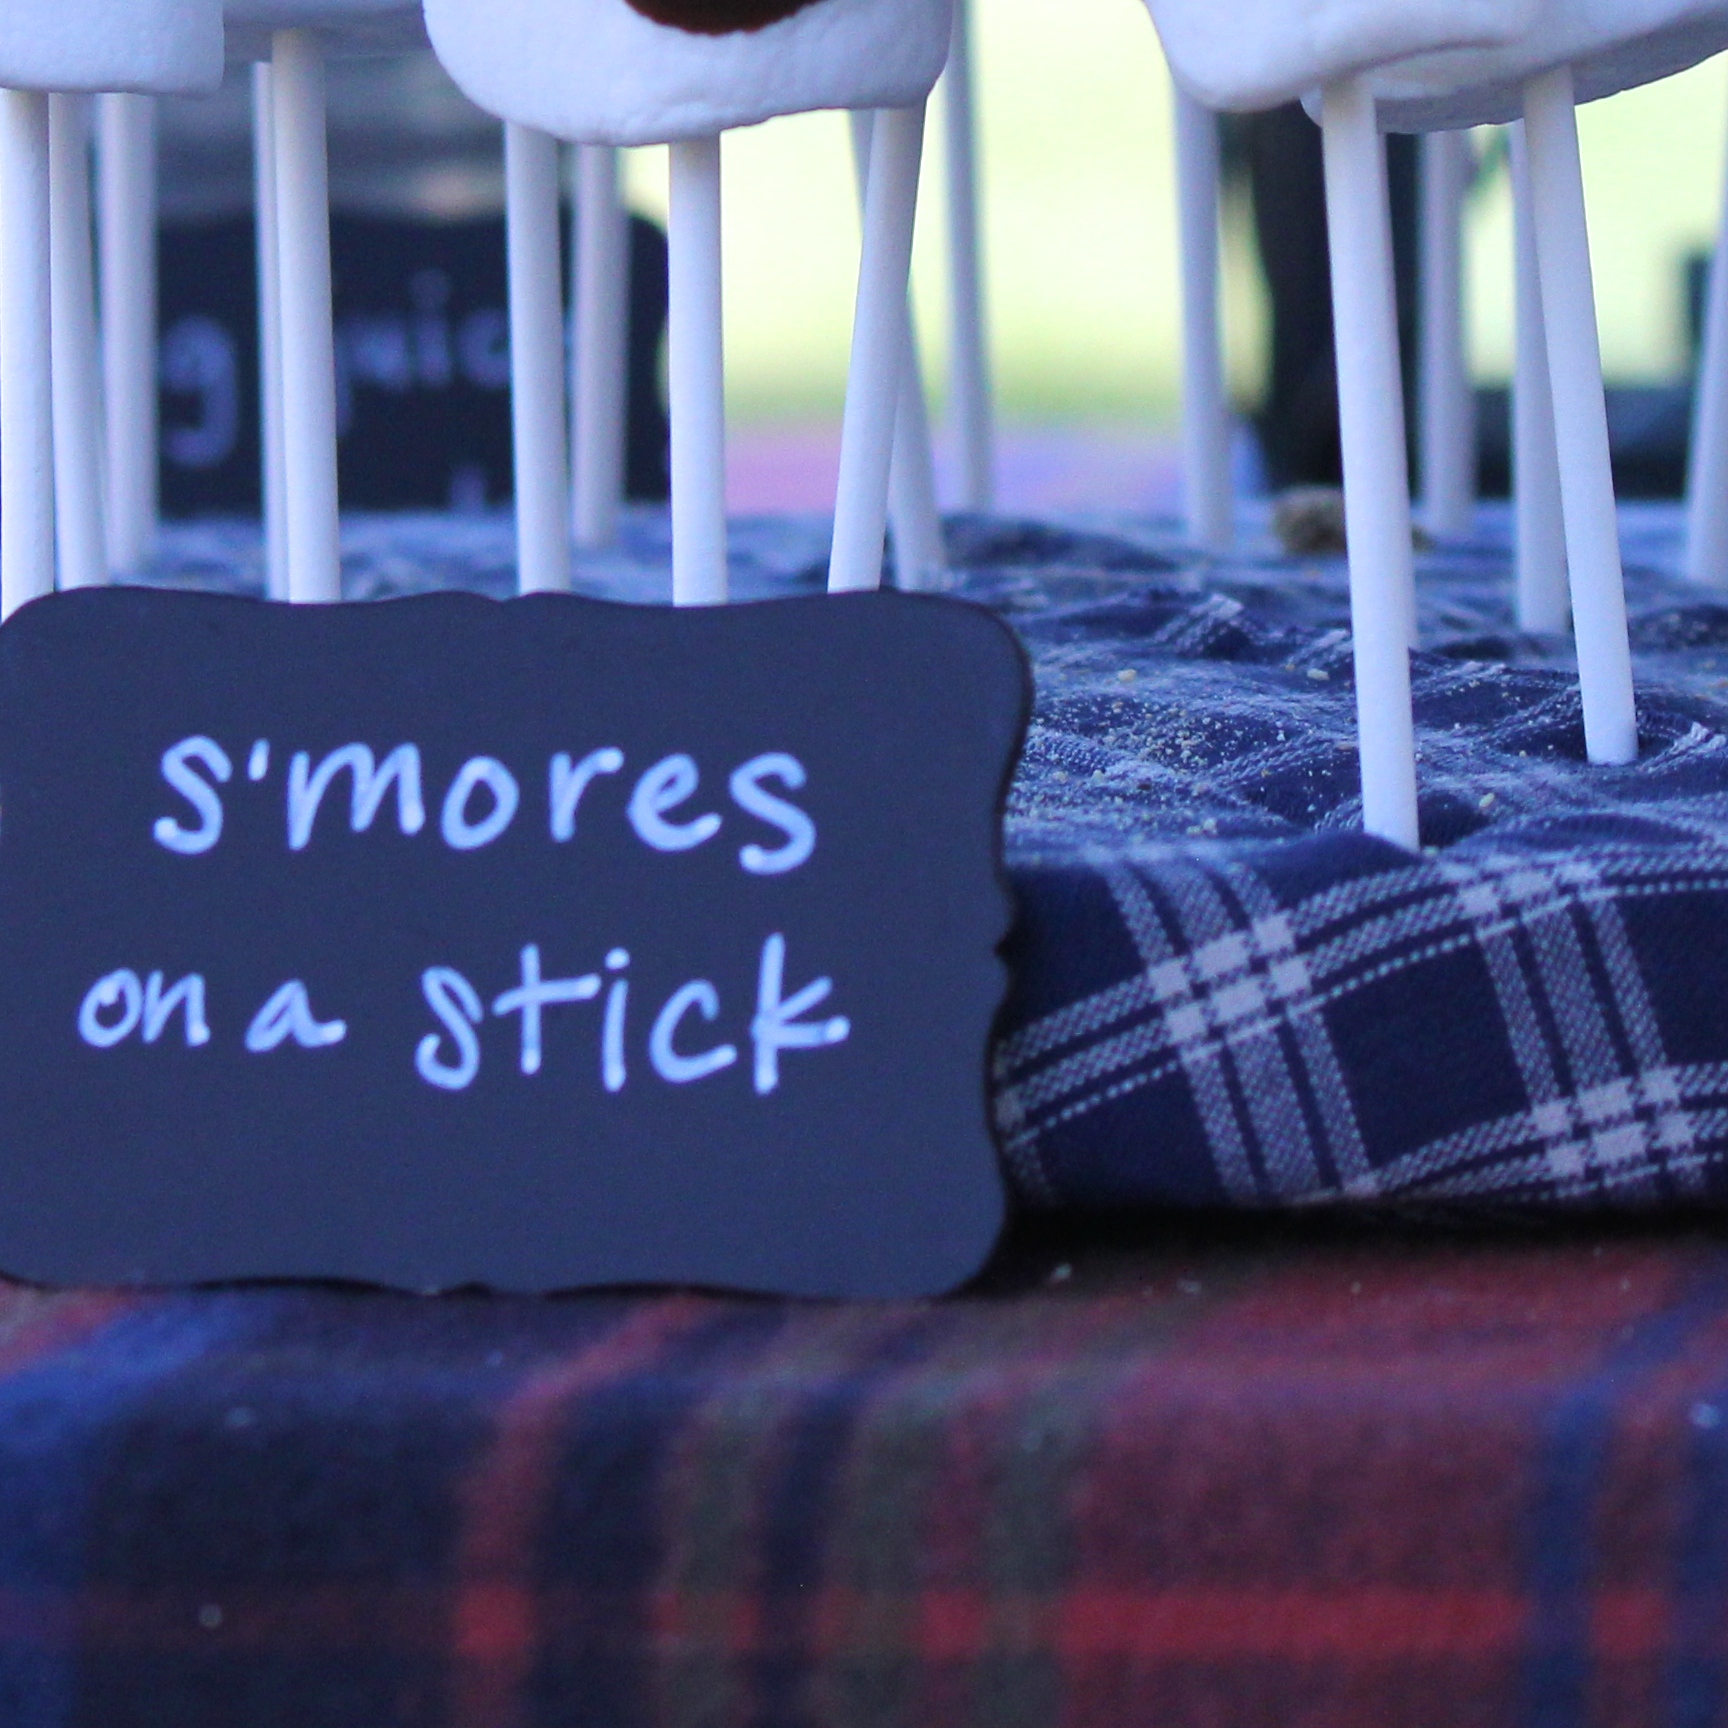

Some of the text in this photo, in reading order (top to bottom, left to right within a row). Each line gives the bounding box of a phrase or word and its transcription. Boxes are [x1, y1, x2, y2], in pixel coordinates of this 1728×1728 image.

[75, 929, 853, 1096] on a stick
